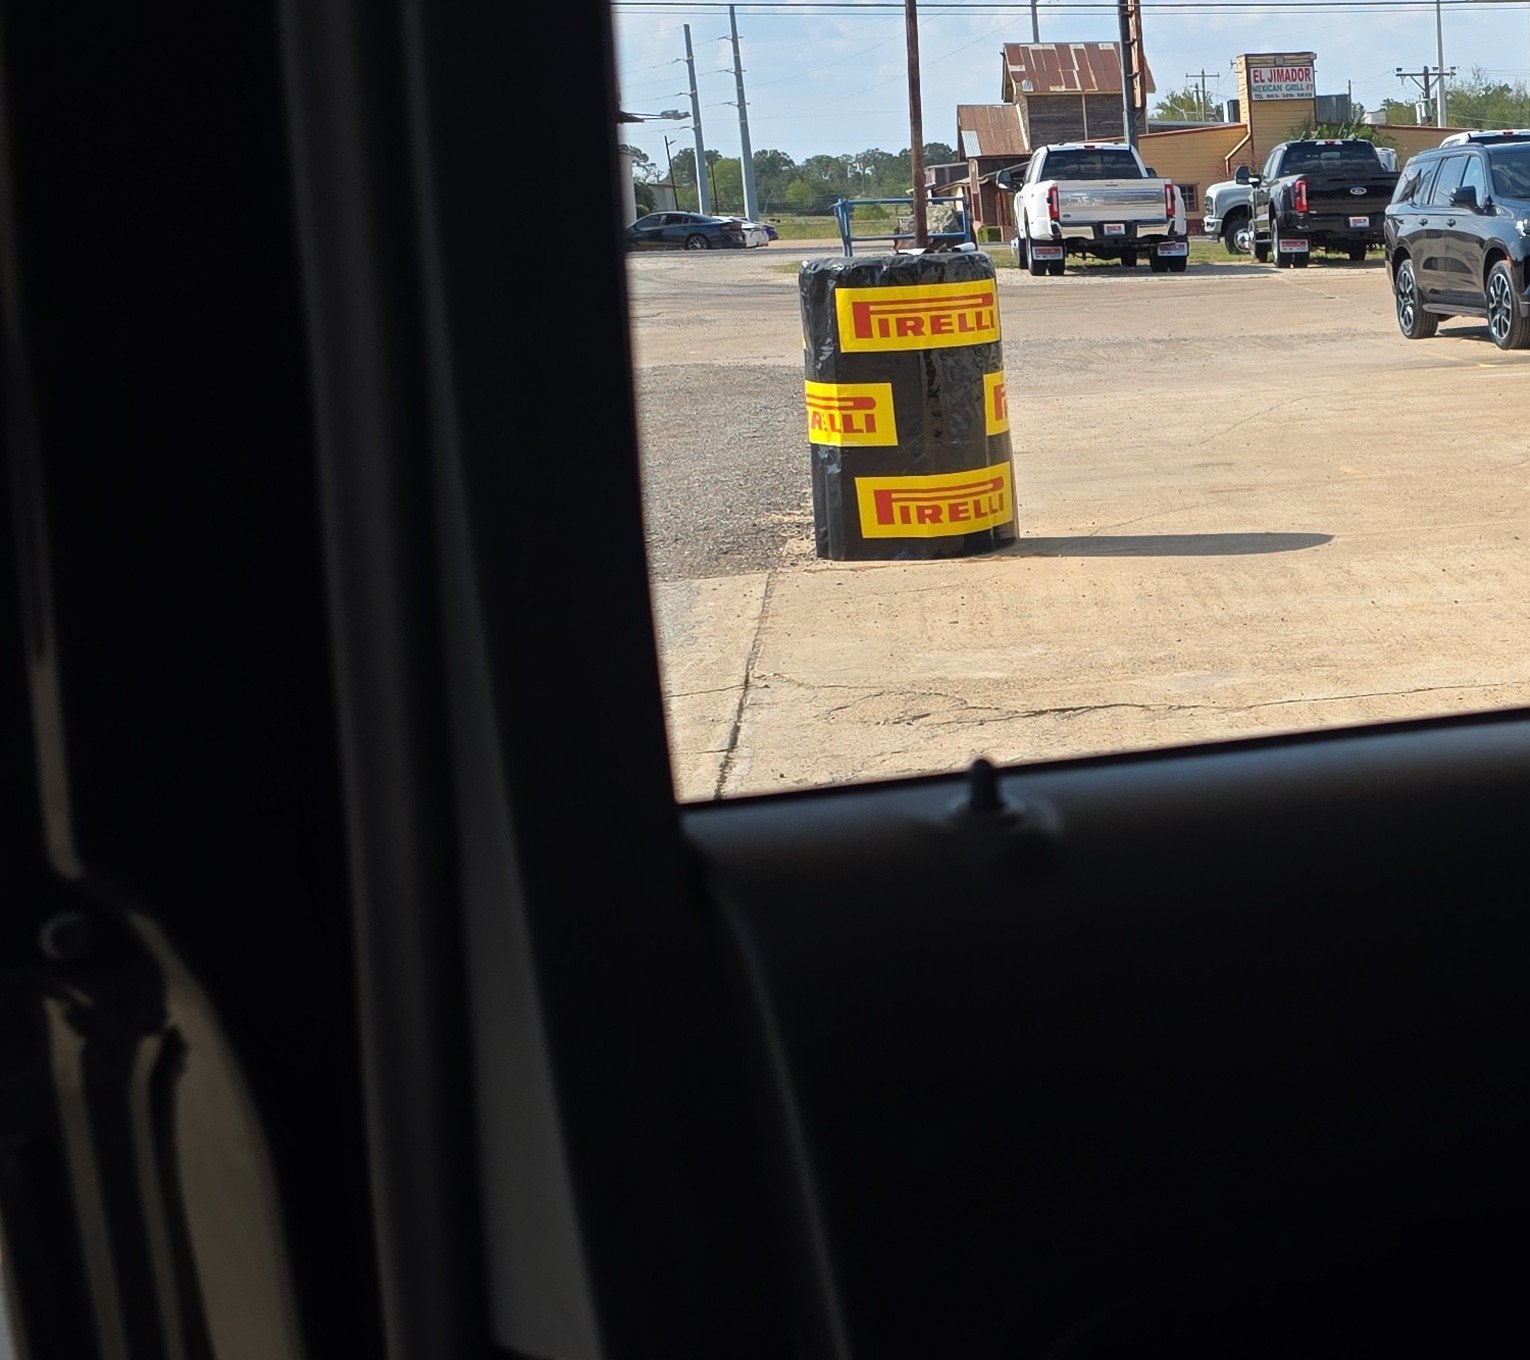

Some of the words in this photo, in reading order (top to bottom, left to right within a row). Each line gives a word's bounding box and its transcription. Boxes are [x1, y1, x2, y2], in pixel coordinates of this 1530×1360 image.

[1252, 84, 1282, 92] MEXICAN
[1285, 83, 1304, 91] GRILL
[1253, 69, 1265, 83] EL
[1268, 67, 1311, 83] JIMADOR
[852, 292, 995, 339] PIRELLI
[873, 476, 1005, 525] PIRELLI
